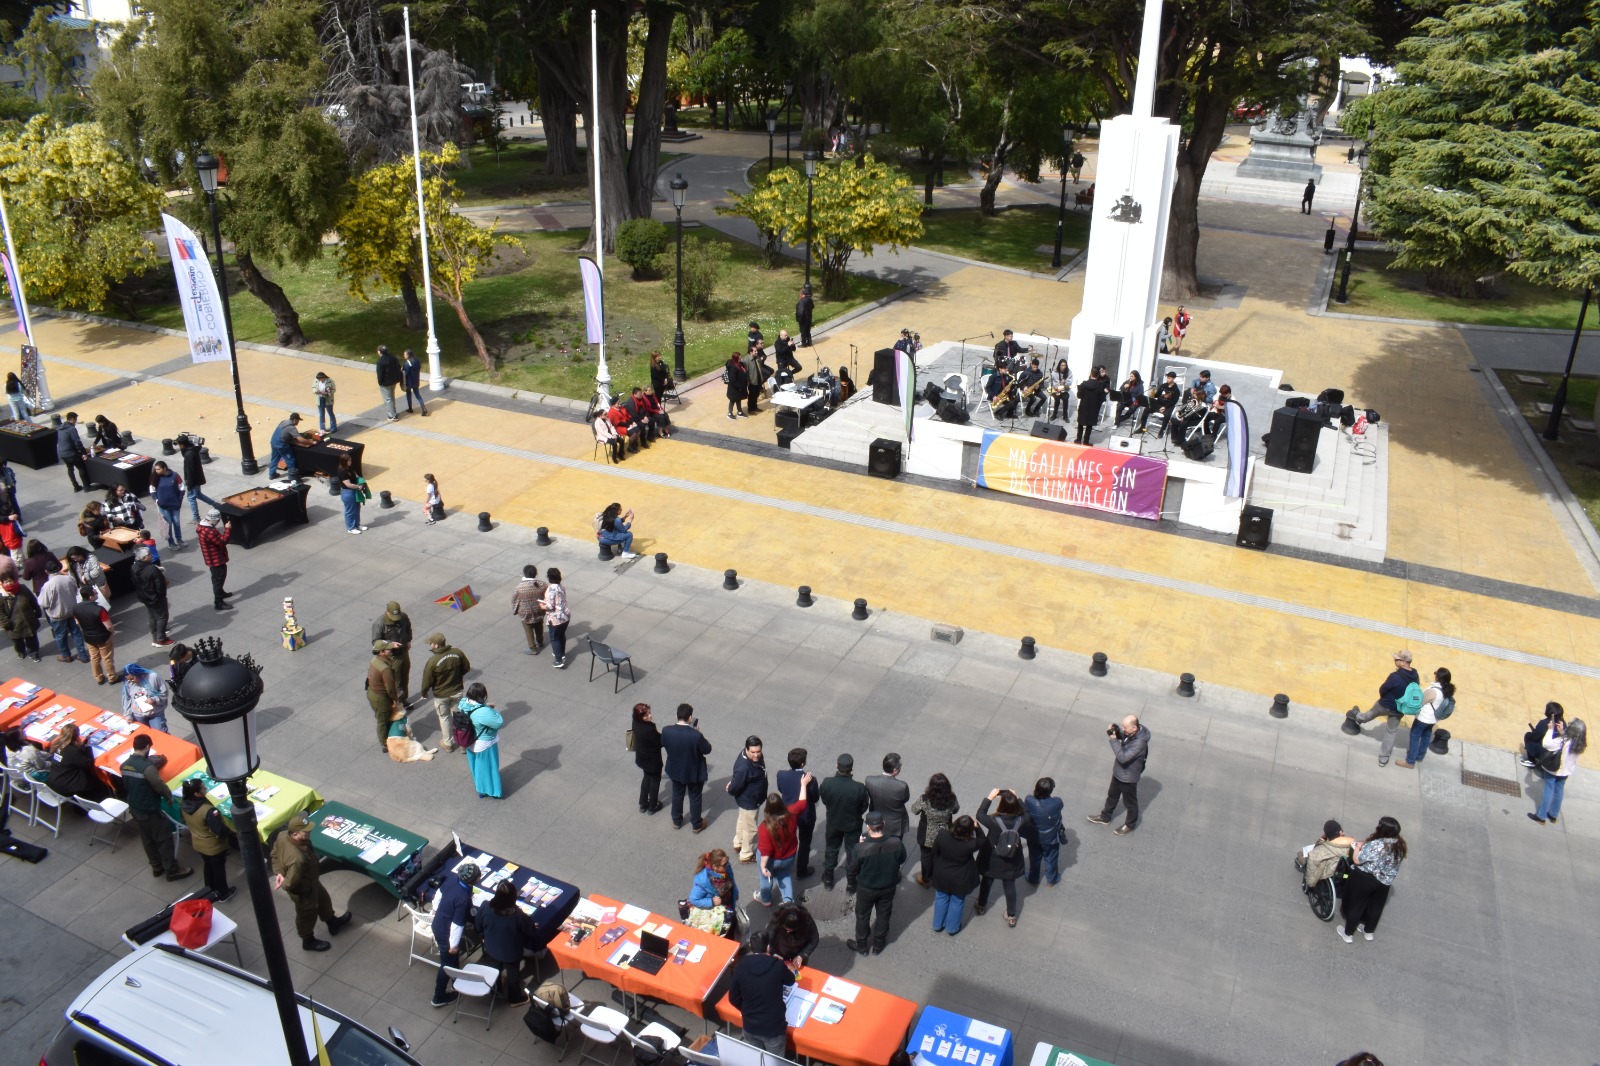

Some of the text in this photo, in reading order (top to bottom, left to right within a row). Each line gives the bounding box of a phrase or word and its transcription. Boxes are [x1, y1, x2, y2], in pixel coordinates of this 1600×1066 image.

[1008, 447, 1137, 490] MAGALLANES SIN
[1009, 471, 1129, 512] DISCRIMINACIÓN
